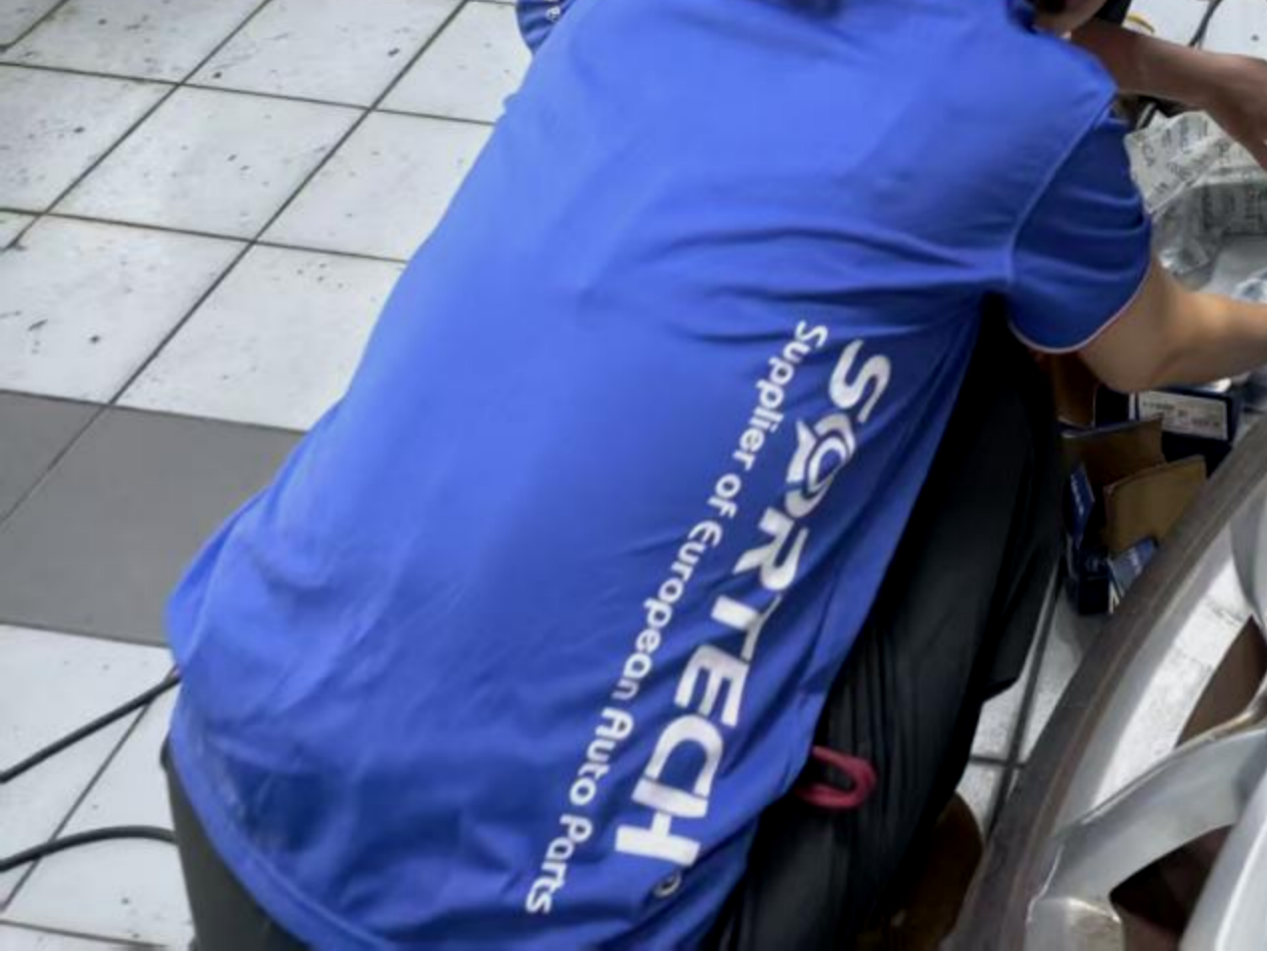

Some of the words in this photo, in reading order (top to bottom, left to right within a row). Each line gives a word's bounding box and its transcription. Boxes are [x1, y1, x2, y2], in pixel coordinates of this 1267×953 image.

[731, 319, 829, 471] Supplier
[706, 472, 743, 520] of
[609, 519, 724, 701] European
[568, 706, 635, 806] Auto
[524, 812, 594, 914] Parts
